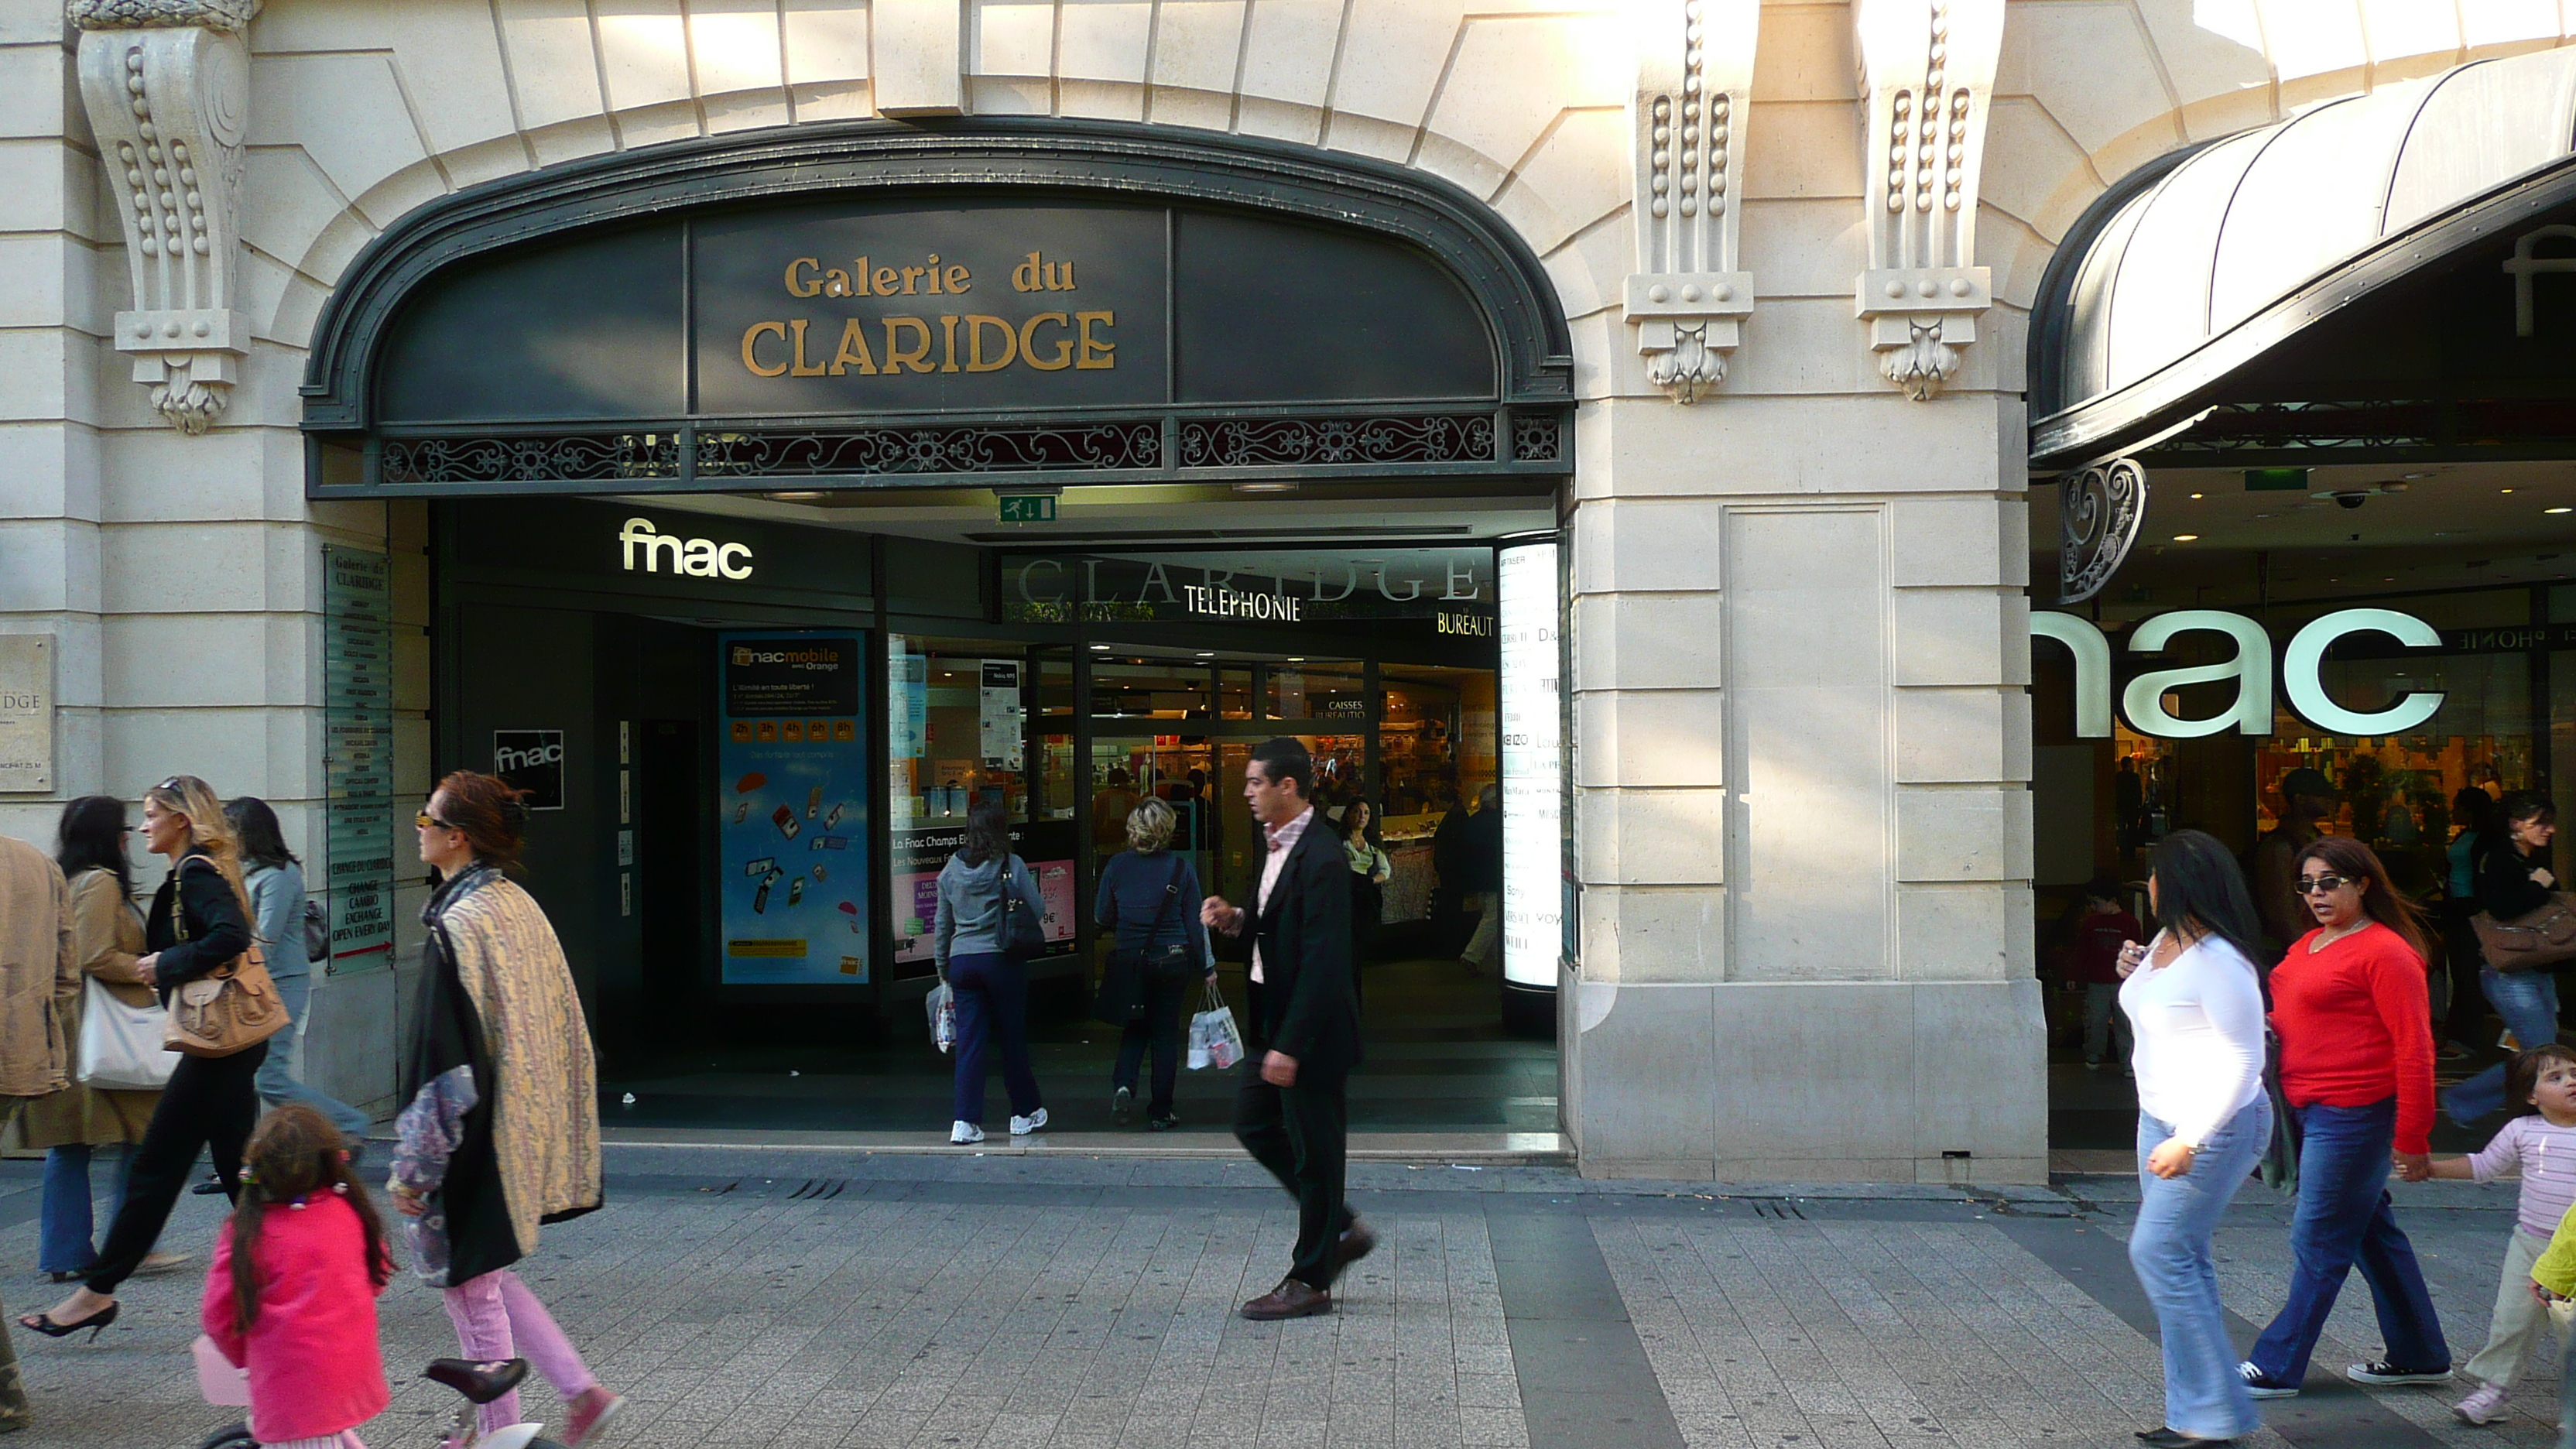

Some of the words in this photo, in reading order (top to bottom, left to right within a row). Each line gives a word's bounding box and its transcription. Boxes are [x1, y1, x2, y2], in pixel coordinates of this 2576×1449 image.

[784, 254, 971, 297] Galerie
[1012, 251, 1076, 292] du
[742, 311, 1115, 377] CLARIDGE
[619, 518, 753, 580] fnac
[336, 573, 384, 591] CLARIDGE
[1019, 559, 1479, 605] CLARIDGE
[1184, 585, 1301, 622] TELEPHONIE
[1437, 611, 1494, 637] BUREAUT
[806, 663, 839, 671] Orange
[1328, 701, 1363, 710] CAISSES
[735, 724, 748, 732] 2h
[761, 724, 773, 732] 3h
[786, 724, 800, 732] 4h
[811, 723, 825, 732] 6h
[496, 744, 563, 773] fnac
[893, 839, 903, 849] La
[905, 838, 925, 848] Fnac
[926, 836, 957, 848] Champs
[893, 858, 905, 867] Les
[907, 855, 943, 866] Nouveaux
[348, 880, 379, 895] CHANGE
[348, 894, 379, 909] CAMBIO
[345, 908, 383, 925] EXCHANGE
[332, 927, 353, 942] OPEN
[355, 923, 376, 938] EVERY
[377, 920, 391, 933] DAY
